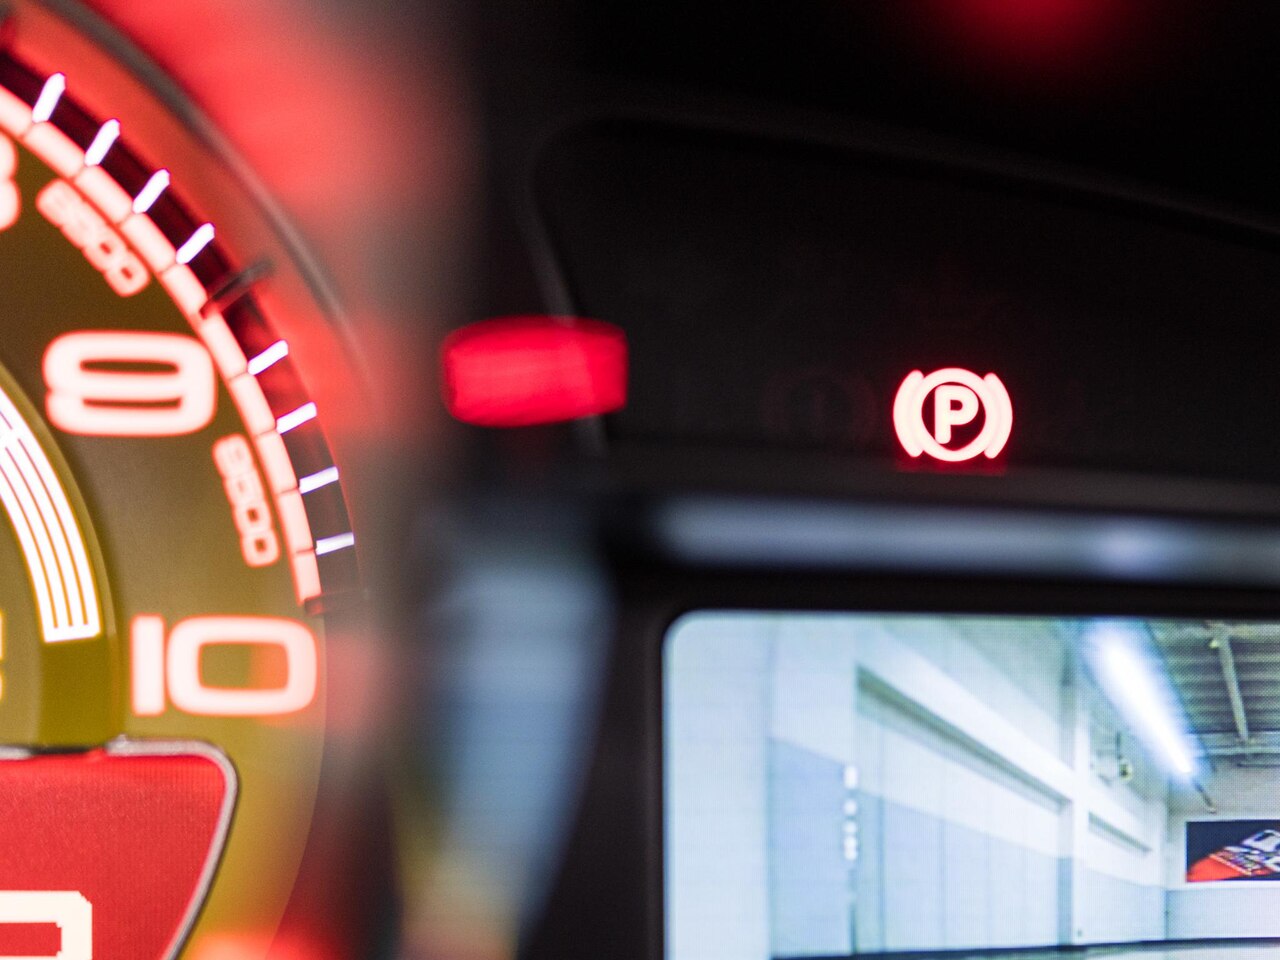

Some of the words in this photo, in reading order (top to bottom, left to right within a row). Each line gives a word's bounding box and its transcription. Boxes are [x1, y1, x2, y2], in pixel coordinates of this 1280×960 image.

[43, 331, 216, 436] 9
[934, 384, 979, 444] P
[130, 614, 318, 716] 10
